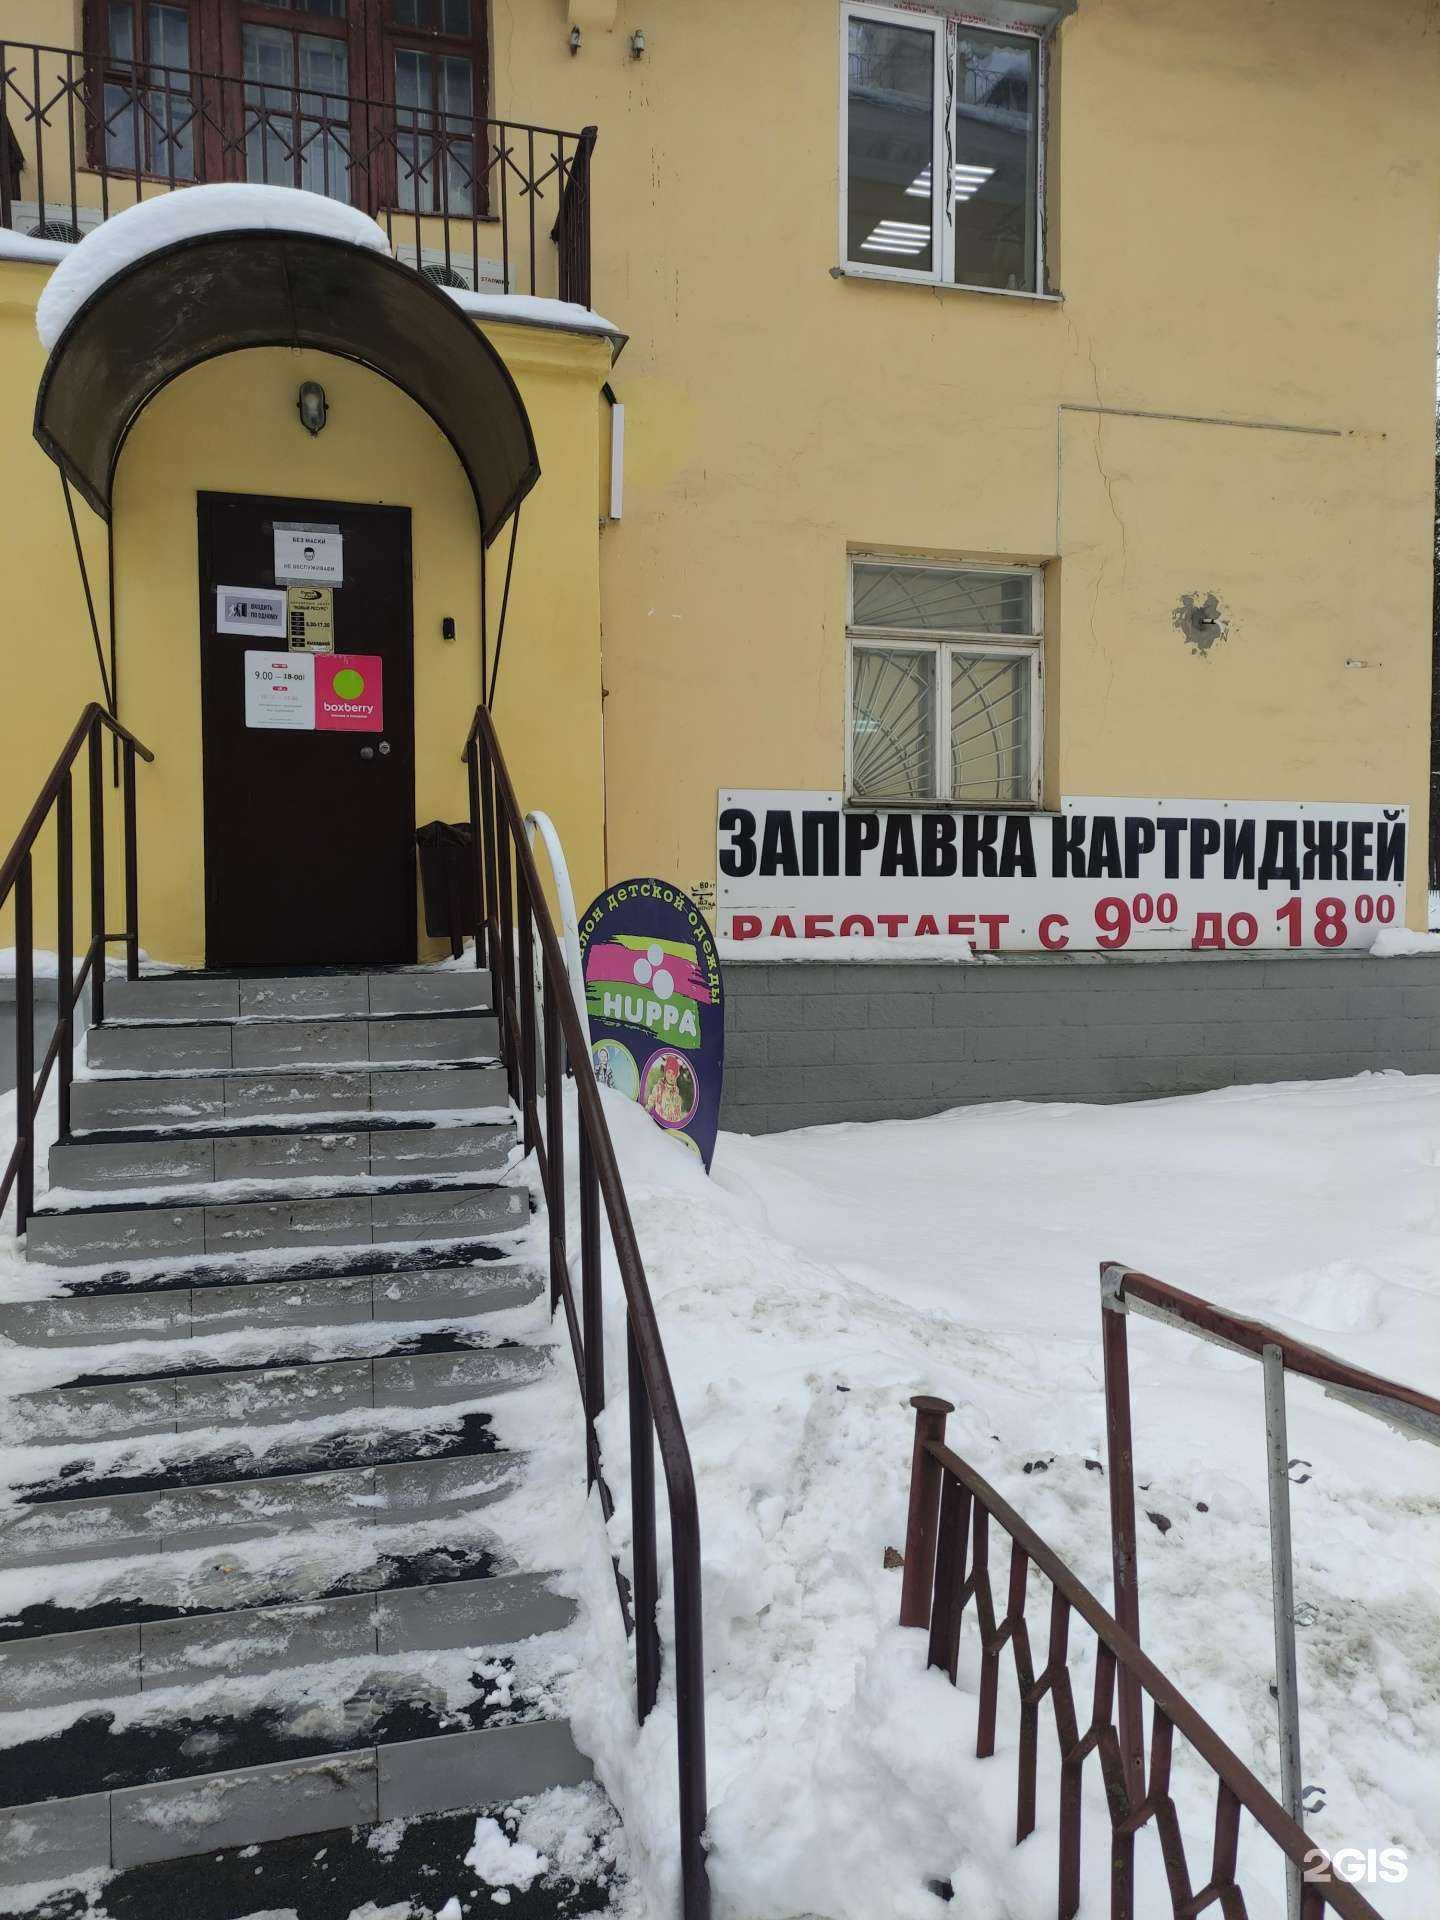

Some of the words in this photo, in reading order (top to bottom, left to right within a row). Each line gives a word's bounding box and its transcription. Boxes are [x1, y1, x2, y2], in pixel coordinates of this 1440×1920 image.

[323, 701, 374, 715] boxberry
[719, 808, 1037, 878] ЗАПРАВКА
[1052, 809, 1406, 890] КАРТРИДЖЕЙ
[603, 991, 697, 1038] HUPPA
